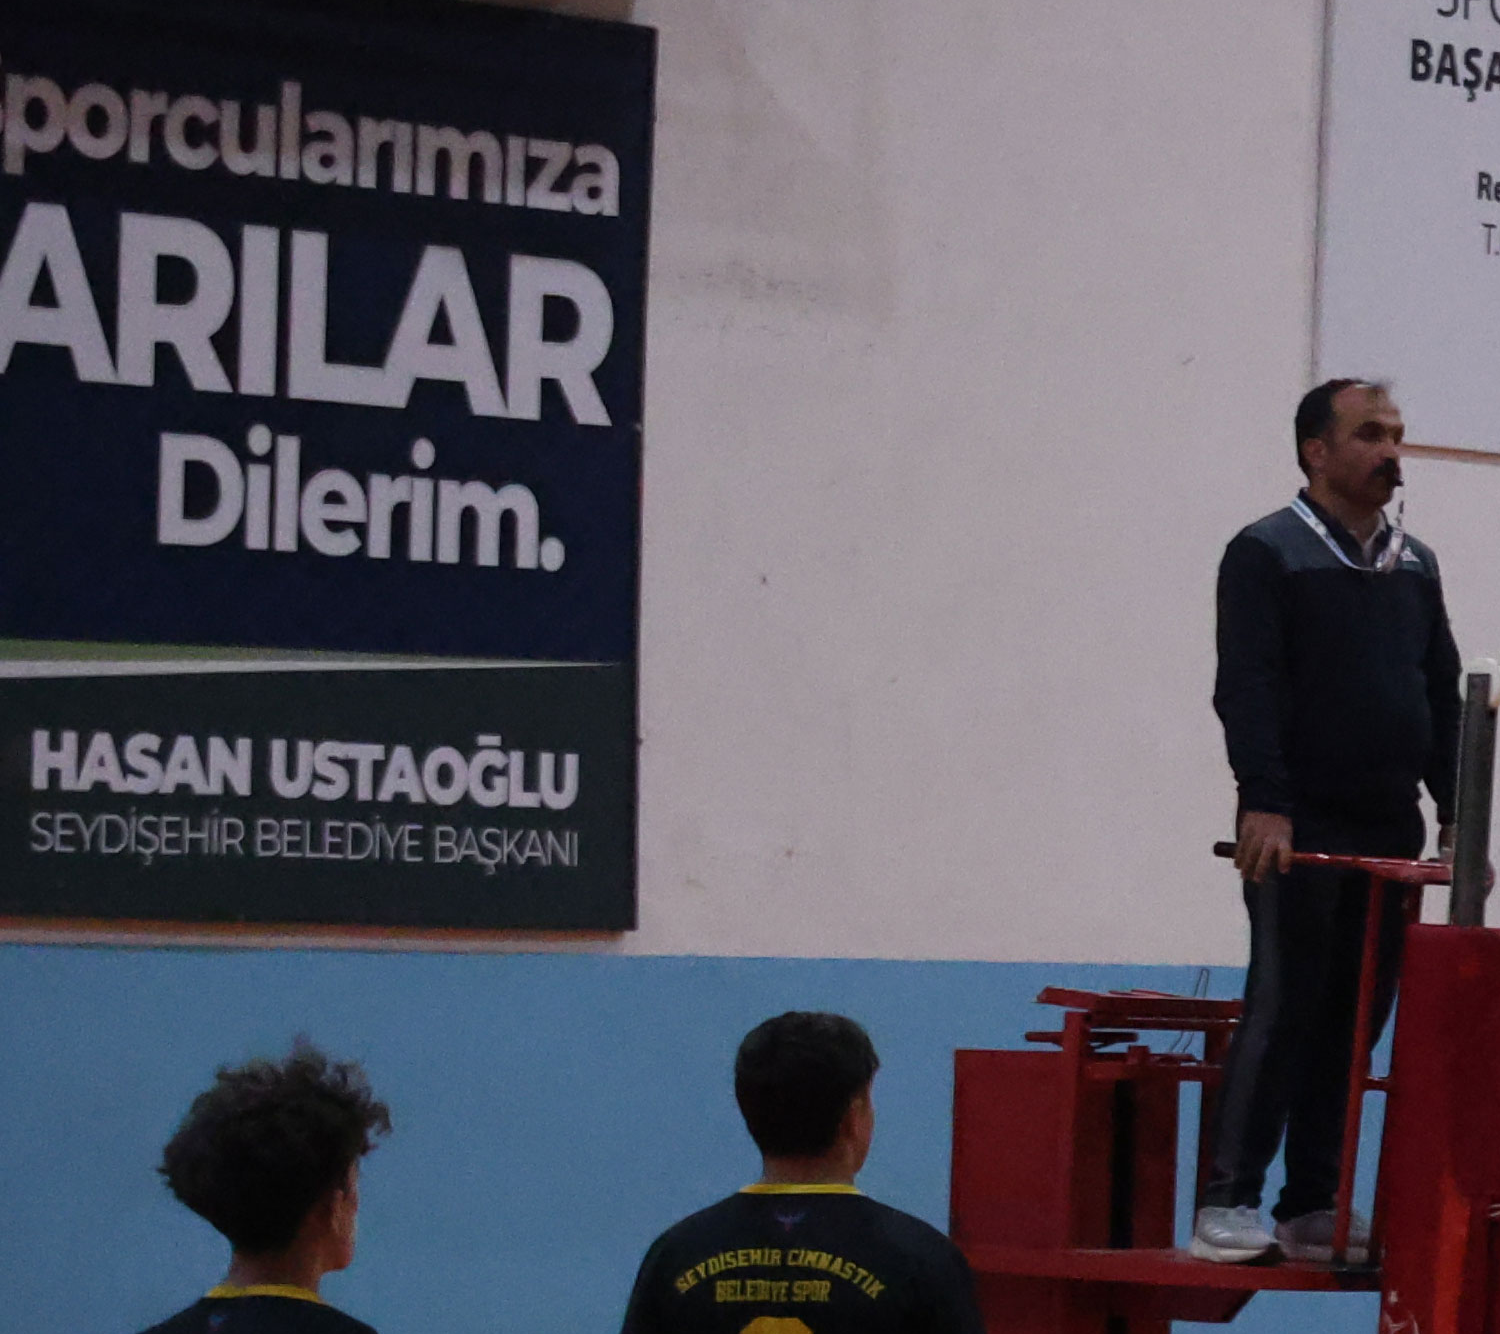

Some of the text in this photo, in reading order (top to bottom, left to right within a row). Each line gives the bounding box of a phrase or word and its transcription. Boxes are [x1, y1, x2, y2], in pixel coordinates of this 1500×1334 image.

[0, 73, 620, 217] porcularımıza
[157, 423, 566, 573] Dilerim.
[31, 729, 580, 810] HASAN USTAOĞLU
[31, 806, 580, 876] SEYDİŞEHİR BELEDİYE BAŞKANI
